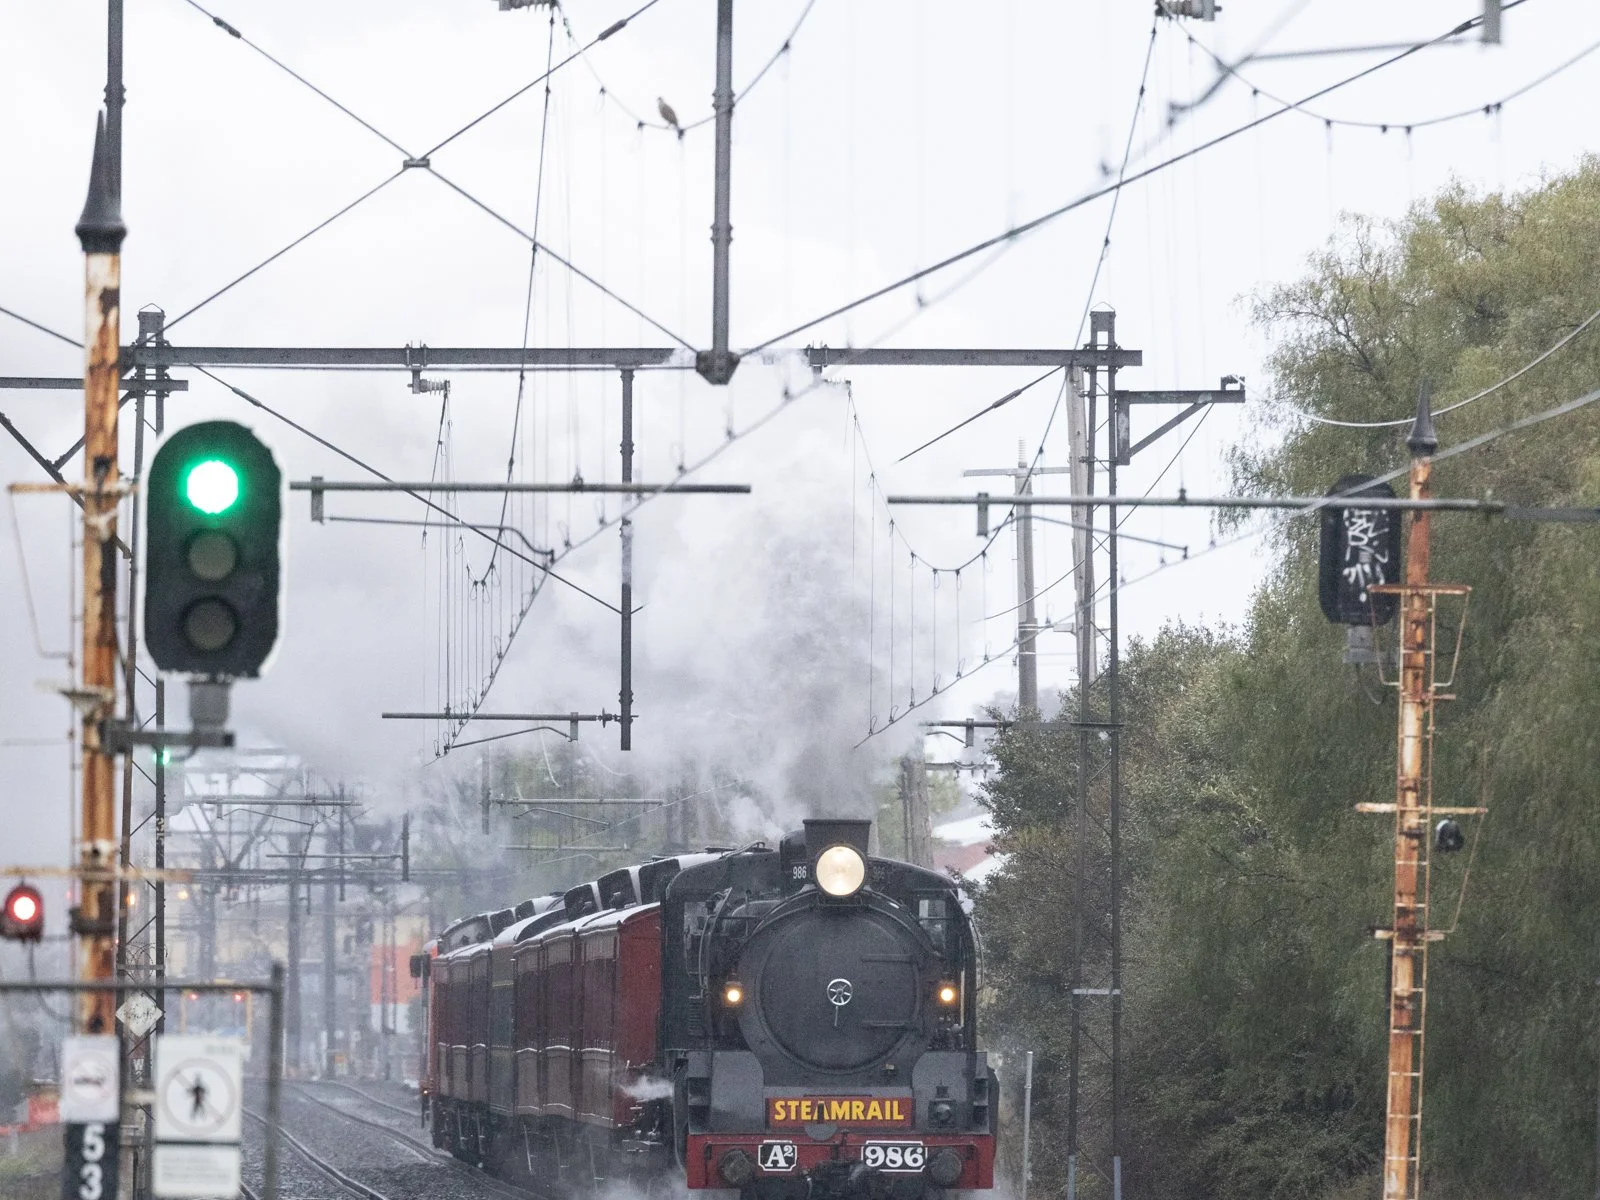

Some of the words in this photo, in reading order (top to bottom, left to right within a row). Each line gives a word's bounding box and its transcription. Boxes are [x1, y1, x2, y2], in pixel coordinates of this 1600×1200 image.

[792, 866, 807, 879] 986
[774, 1100, 904, 1121] STEAMRAIL
[865, 1146, 924, 1168] 986
